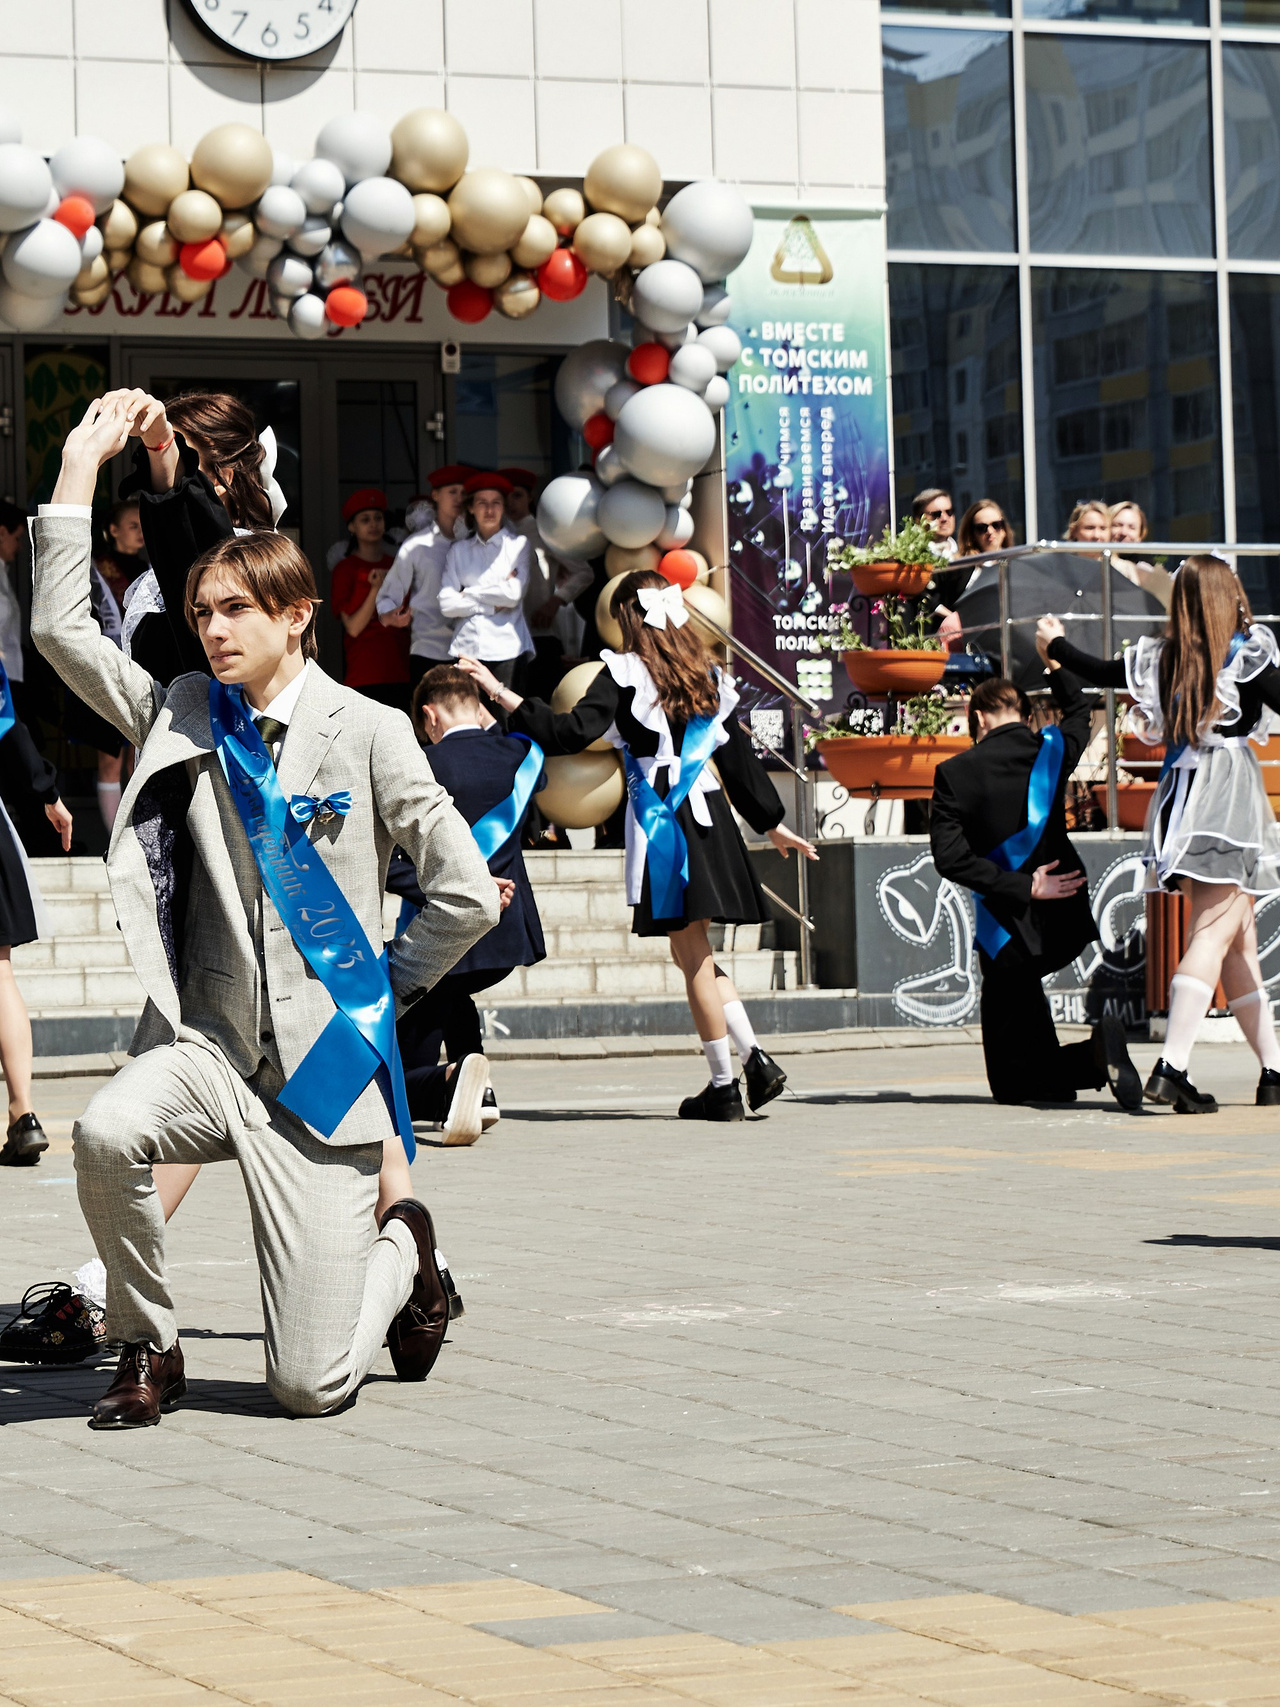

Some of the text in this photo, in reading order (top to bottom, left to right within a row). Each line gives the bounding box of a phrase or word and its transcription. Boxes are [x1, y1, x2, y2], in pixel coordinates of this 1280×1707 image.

[231, 11, 248, 37] 7
[261, 22, 278, 47] 6
[294, 13, 309, 39] 5
[761, 321, 845, 343] ВМЕСТЕ
[740, 346, 868, 369] С ТОМСКИМ
[738, 374, 873, 396] ПОЛИТЕХОМ
[297, 900, 366, 970] 2023
